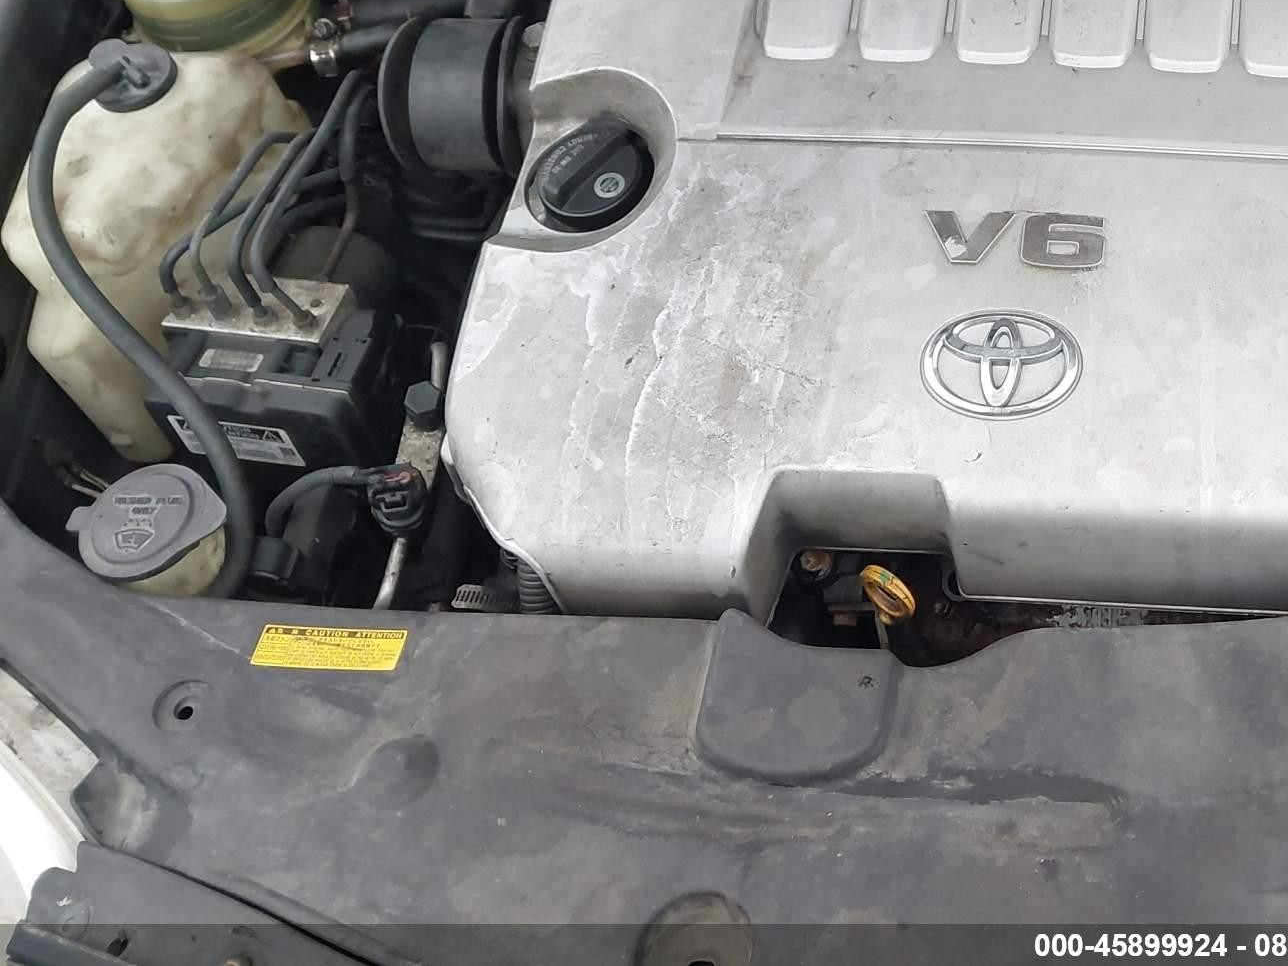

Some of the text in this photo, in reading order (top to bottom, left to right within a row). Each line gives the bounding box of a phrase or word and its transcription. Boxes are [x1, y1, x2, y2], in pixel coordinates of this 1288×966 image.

[924, 210, 1107, 270] V6
[305, 629, 349, 637] CAUTION
[355, 631, 403, 639] ATTENTION
